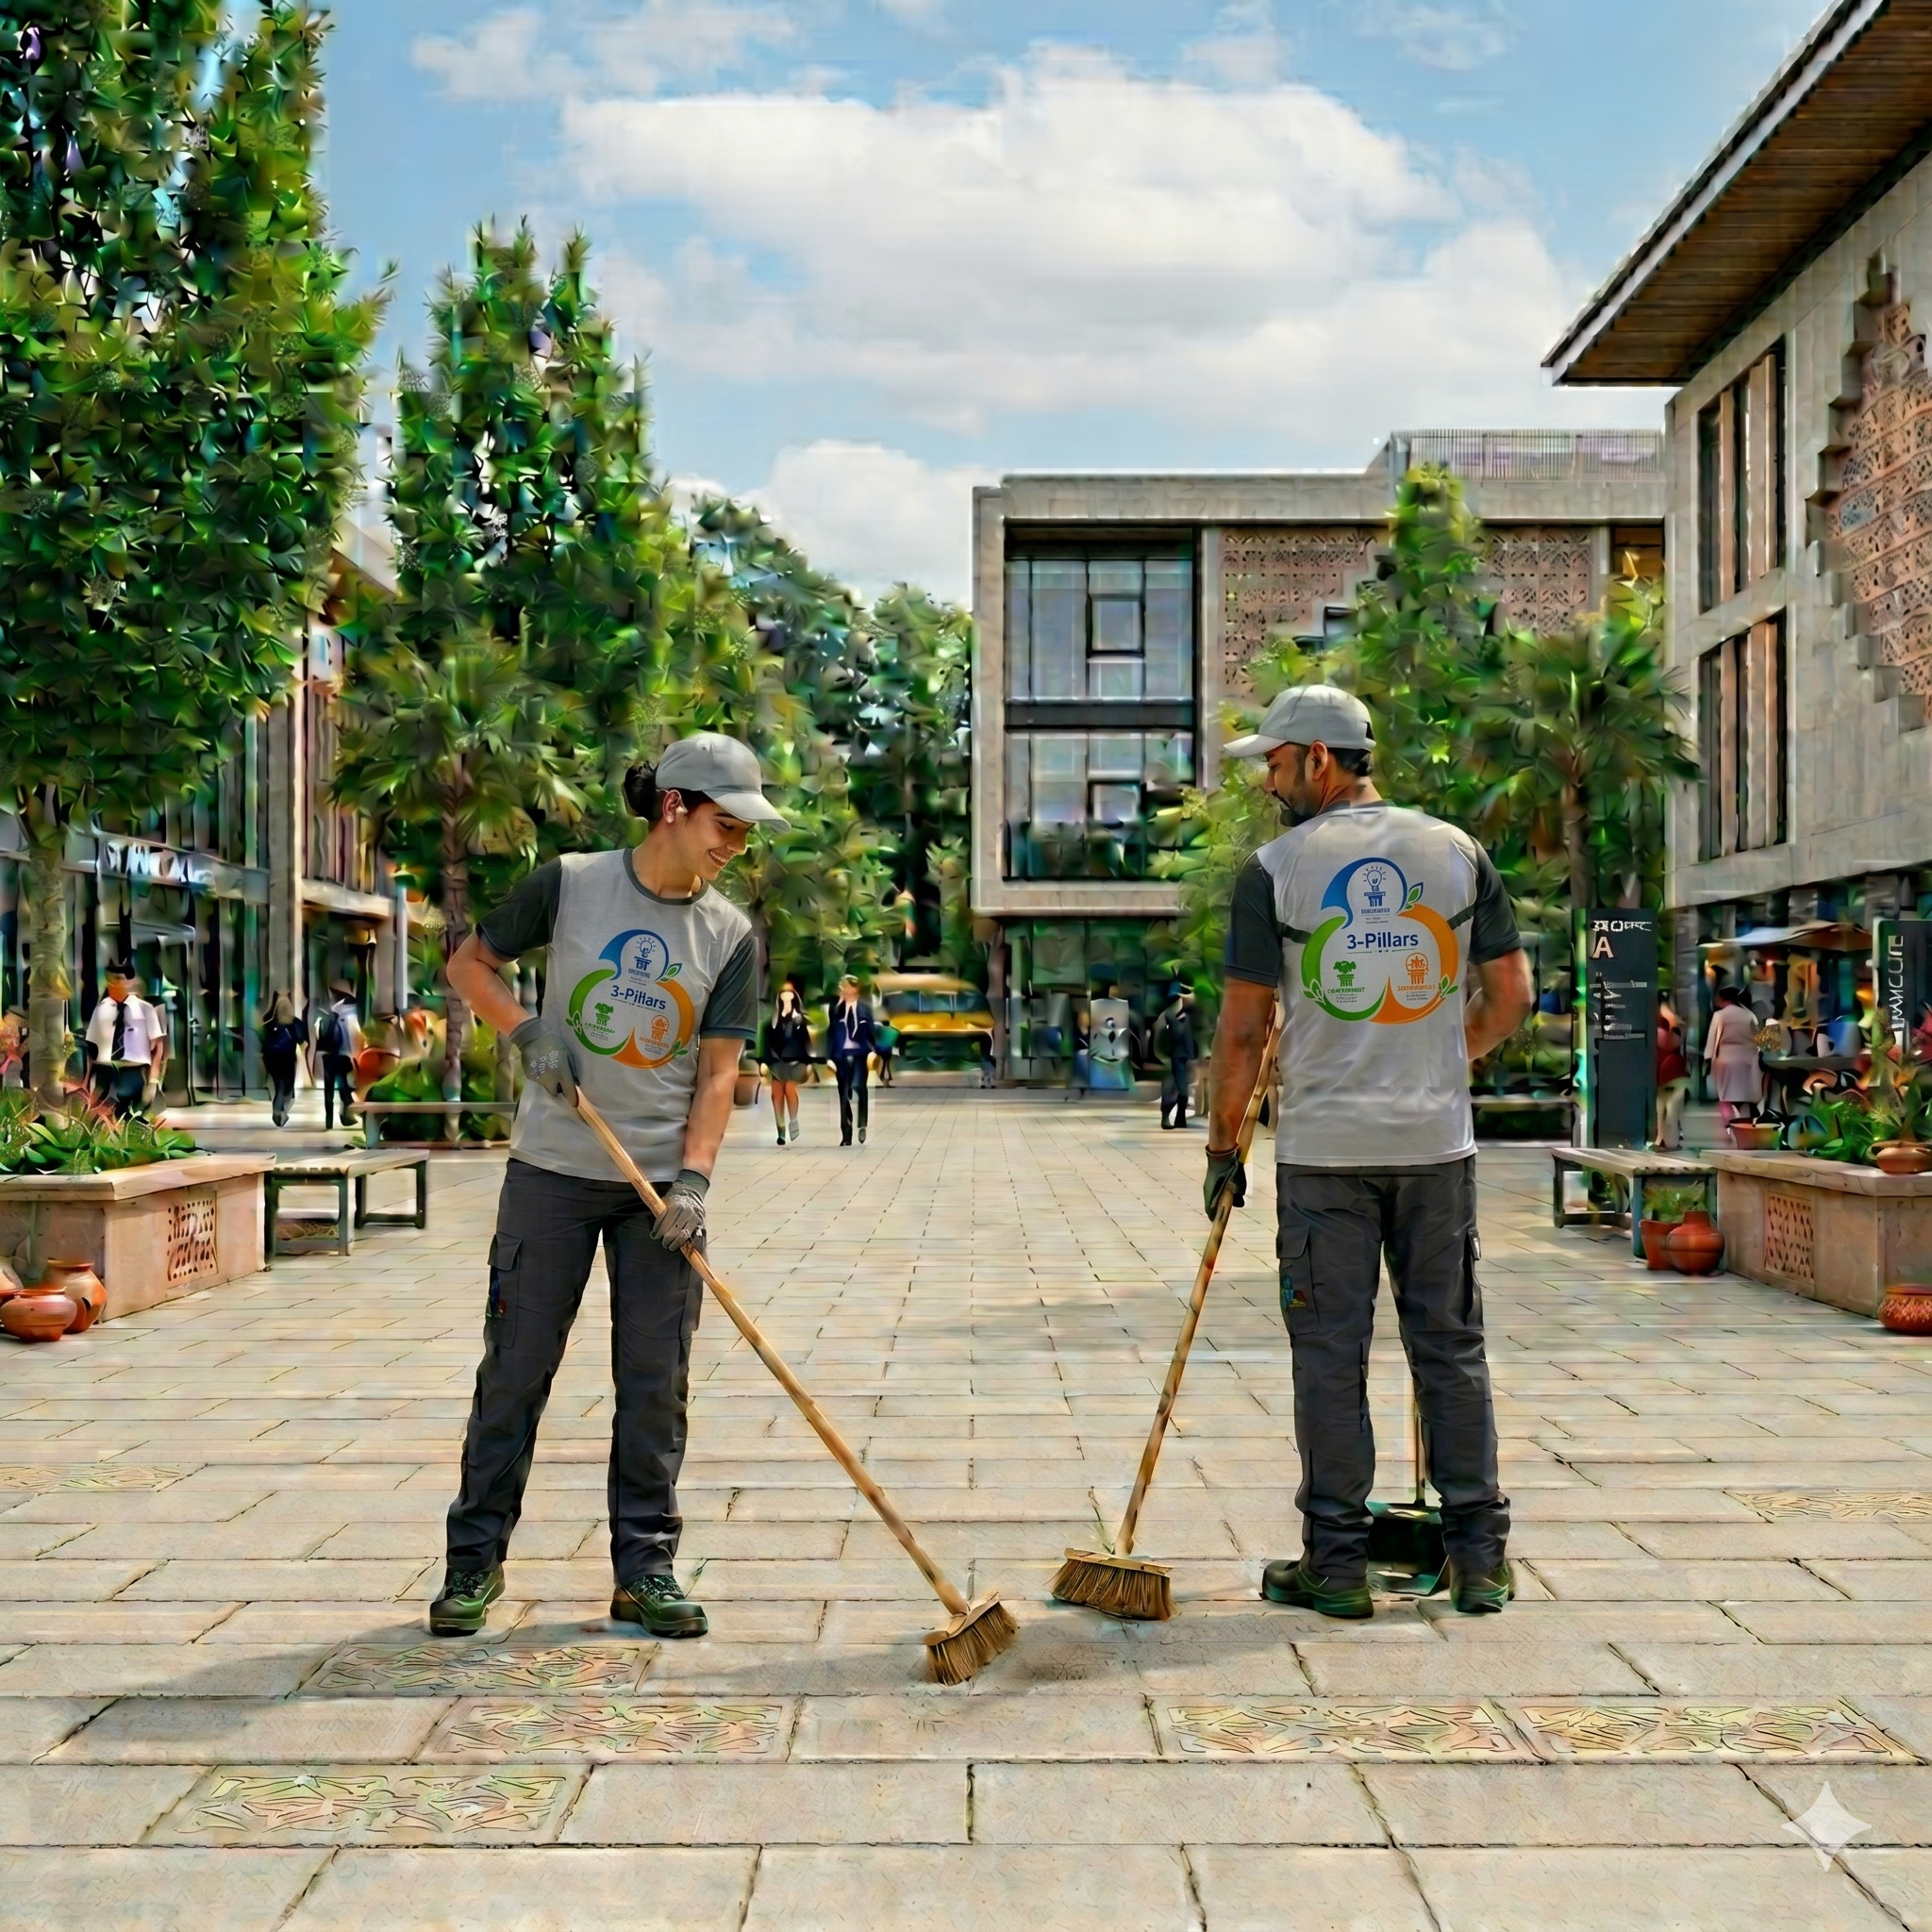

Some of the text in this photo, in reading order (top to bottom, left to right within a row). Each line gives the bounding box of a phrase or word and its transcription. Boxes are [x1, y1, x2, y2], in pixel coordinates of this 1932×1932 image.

[1346, 931, 1419, 950] 3-Pillars
[1591, 936, 1614, 958] A
[610, 985, 667, 1010] 3-Pillars
